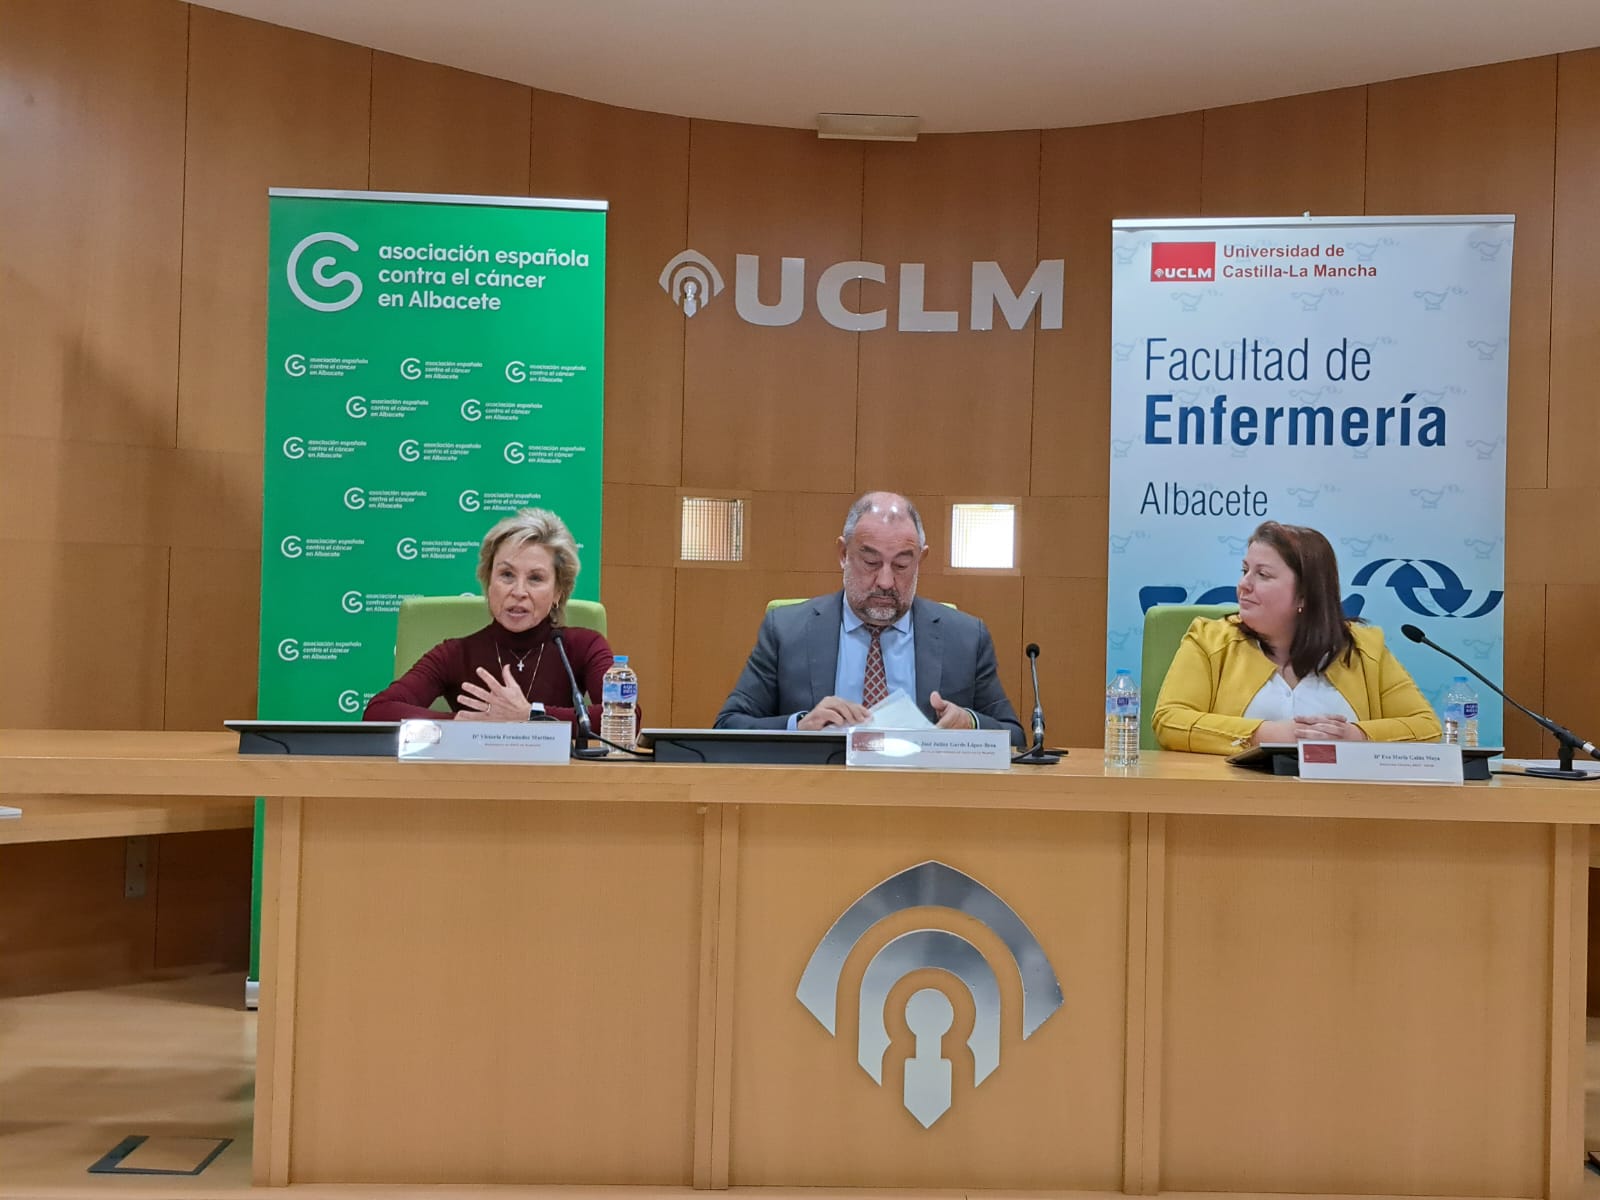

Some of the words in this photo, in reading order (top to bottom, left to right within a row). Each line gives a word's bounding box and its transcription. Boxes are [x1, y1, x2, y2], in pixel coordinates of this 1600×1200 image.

[378, 243, 489, 264] asociación
[495, 248, 589, 269] española
[1223, 244, 1320, 258] Universidad
[1325, 244, 1345, 257] de
[378, 267, 446, 285] contra
[451, 268, 470, 286] el
[475, 270, 546, 289] cáncer
[1164, 267, 1212, 279] UCLM
[1222, 264, 1308, 279] Castilla-La
[1313, 264, 1377, 278] Mancha
[378, 291, 404, 308] en
[408, 290, 501, 310] Albacete
[735, 254, 1065, 332] UCLM
[1145, 338, 1309, 382] Facultad
[1326, 337, 1371, 382] de
[1144, 393, 1447, 447] Enfermería
[1140, 481, 1268, 517] Albacete
